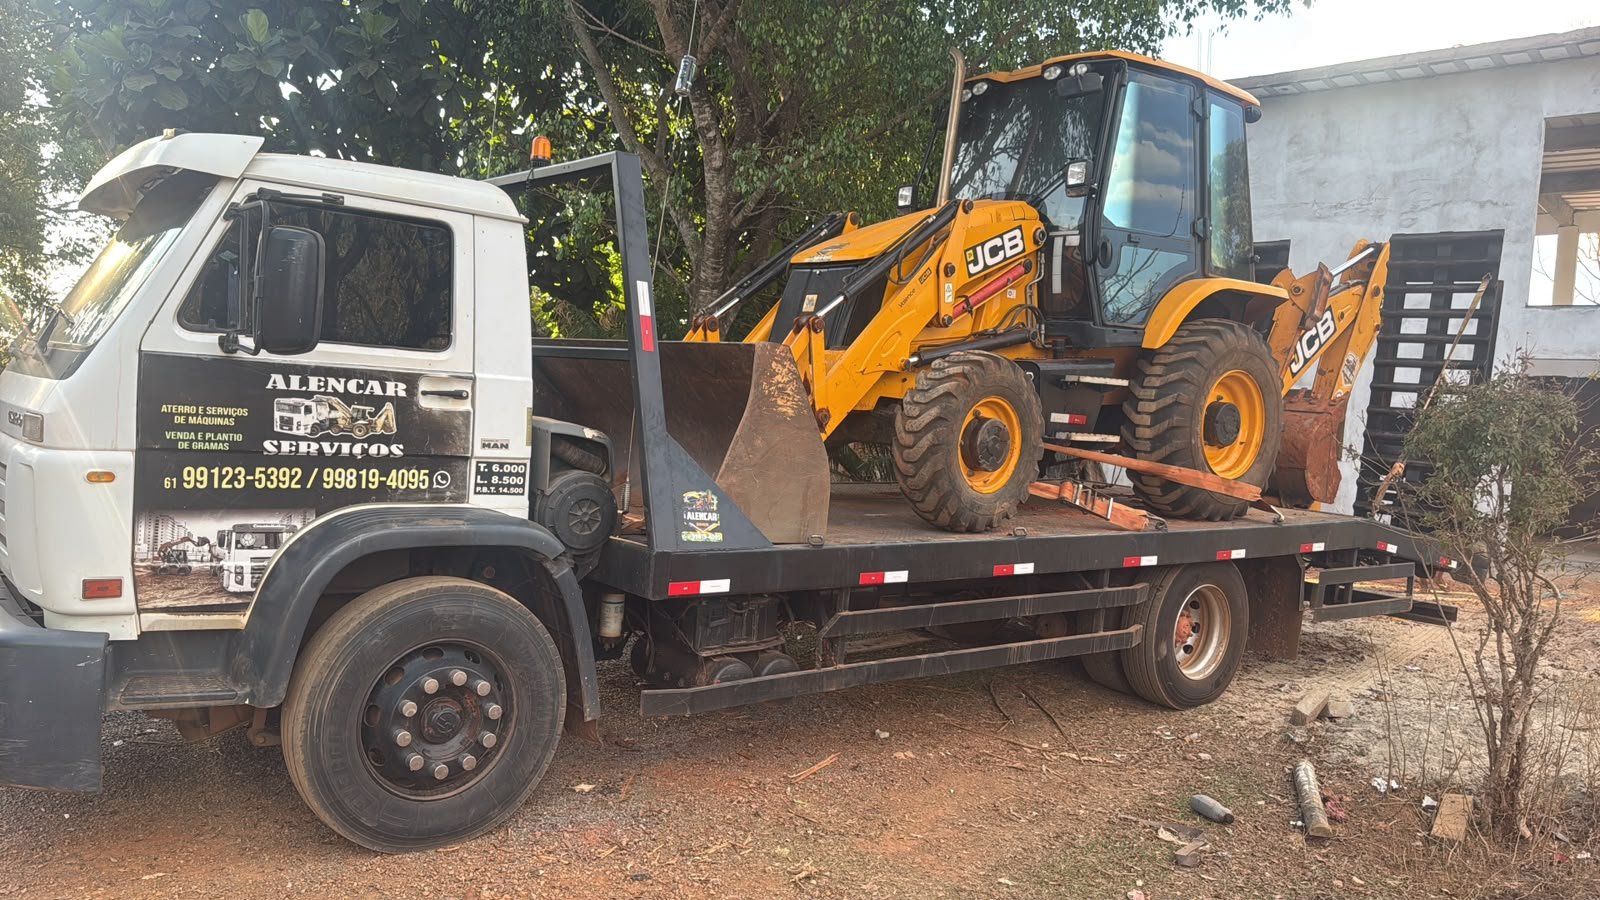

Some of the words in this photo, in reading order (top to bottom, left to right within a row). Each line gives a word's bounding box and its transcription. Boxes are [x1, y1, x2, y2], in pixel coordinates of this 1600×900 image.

[968, 228, 1024, 275] JCB
[1290, 310, 1335, 374] JCB
[265, 373, 408, 397] ALENCAR
[161, 404, 197, 414] ATERRO
[198, 406, 204, 415] E
[206, 406, 249, 417] SERVIÇOS
[174, 415, 186, 424] DE
[188, 415, 235, 426] MÁQUINAS
[165, 431, 196, 440] VENDA
[198, 432, 204, 440] E
[205, 432, 243, 442] PLANTIO
[177, 441, 190, 450] DE
[192, 441, 230, 451] GRAMAS
[262, 439, 405, 459] SERVIÇOS
[478, 463, 488, 472] T.
[492, 464, 525, 473] 6.000
[163, 477, 177, 489] 61
[182, 466, 302, 489] 99123-5392
[306, 467, 319, 489] /
[322, 467, 430, 489] 99819-4095
[476, 475, 487, 484] L.
[491, 475, 524, 485] 8.500
[686, 511, 717, 521] ALENCAR
